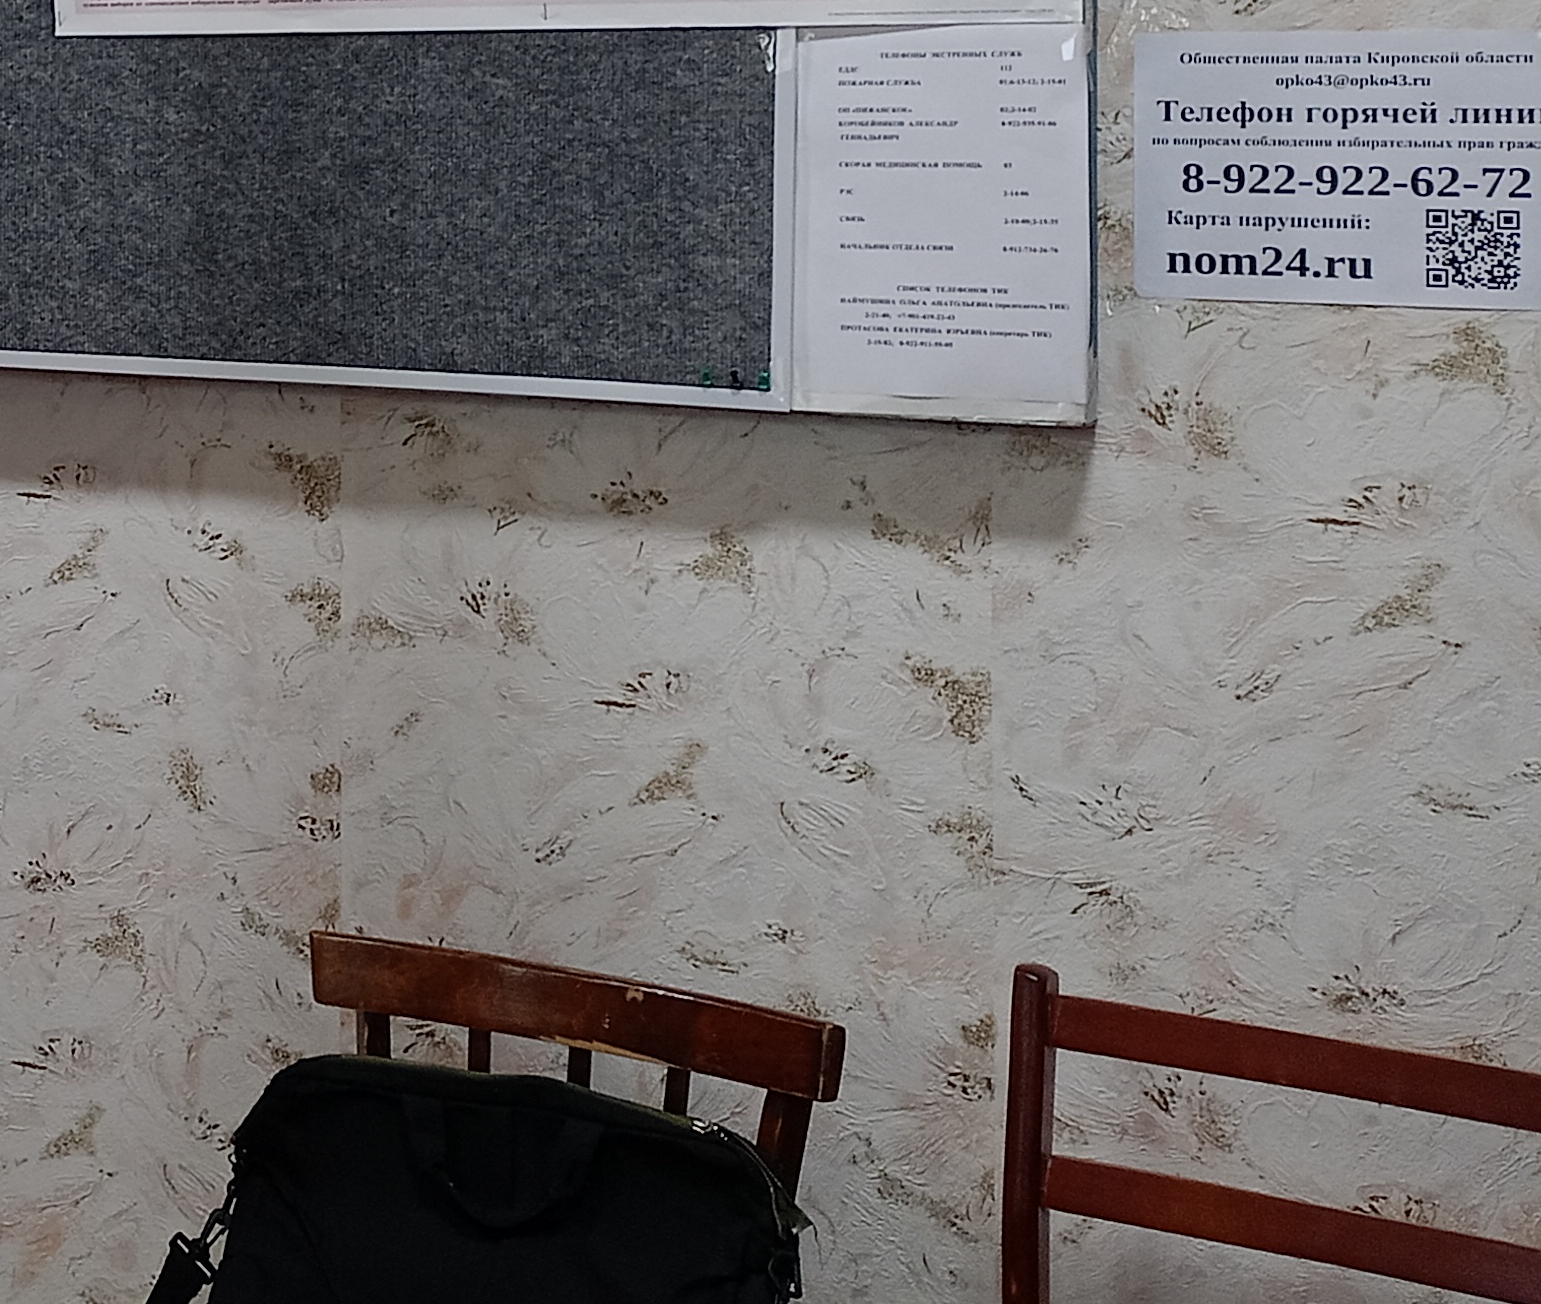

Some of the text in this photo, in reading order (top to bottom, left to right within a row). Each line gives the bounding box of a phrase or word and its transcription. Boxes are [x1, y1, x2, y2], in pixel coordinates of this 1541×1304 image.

[1180, 51, 1534, 67] Общественная палата Кировской области
[1275, 74, 1431, 89] opko43@opko43.ru
[1156, 99, 1541, 129] Телефон горячей лини
[1151, 135, 1541, 152] по вопросам соблюдения избирательных прав граж
[1181, 163, 1532, 199] 8-922-922-62-72
[1166, 210, 1371, 231] Карта нарушений:
[1166, 246, 1374, 279] nom24.ru
